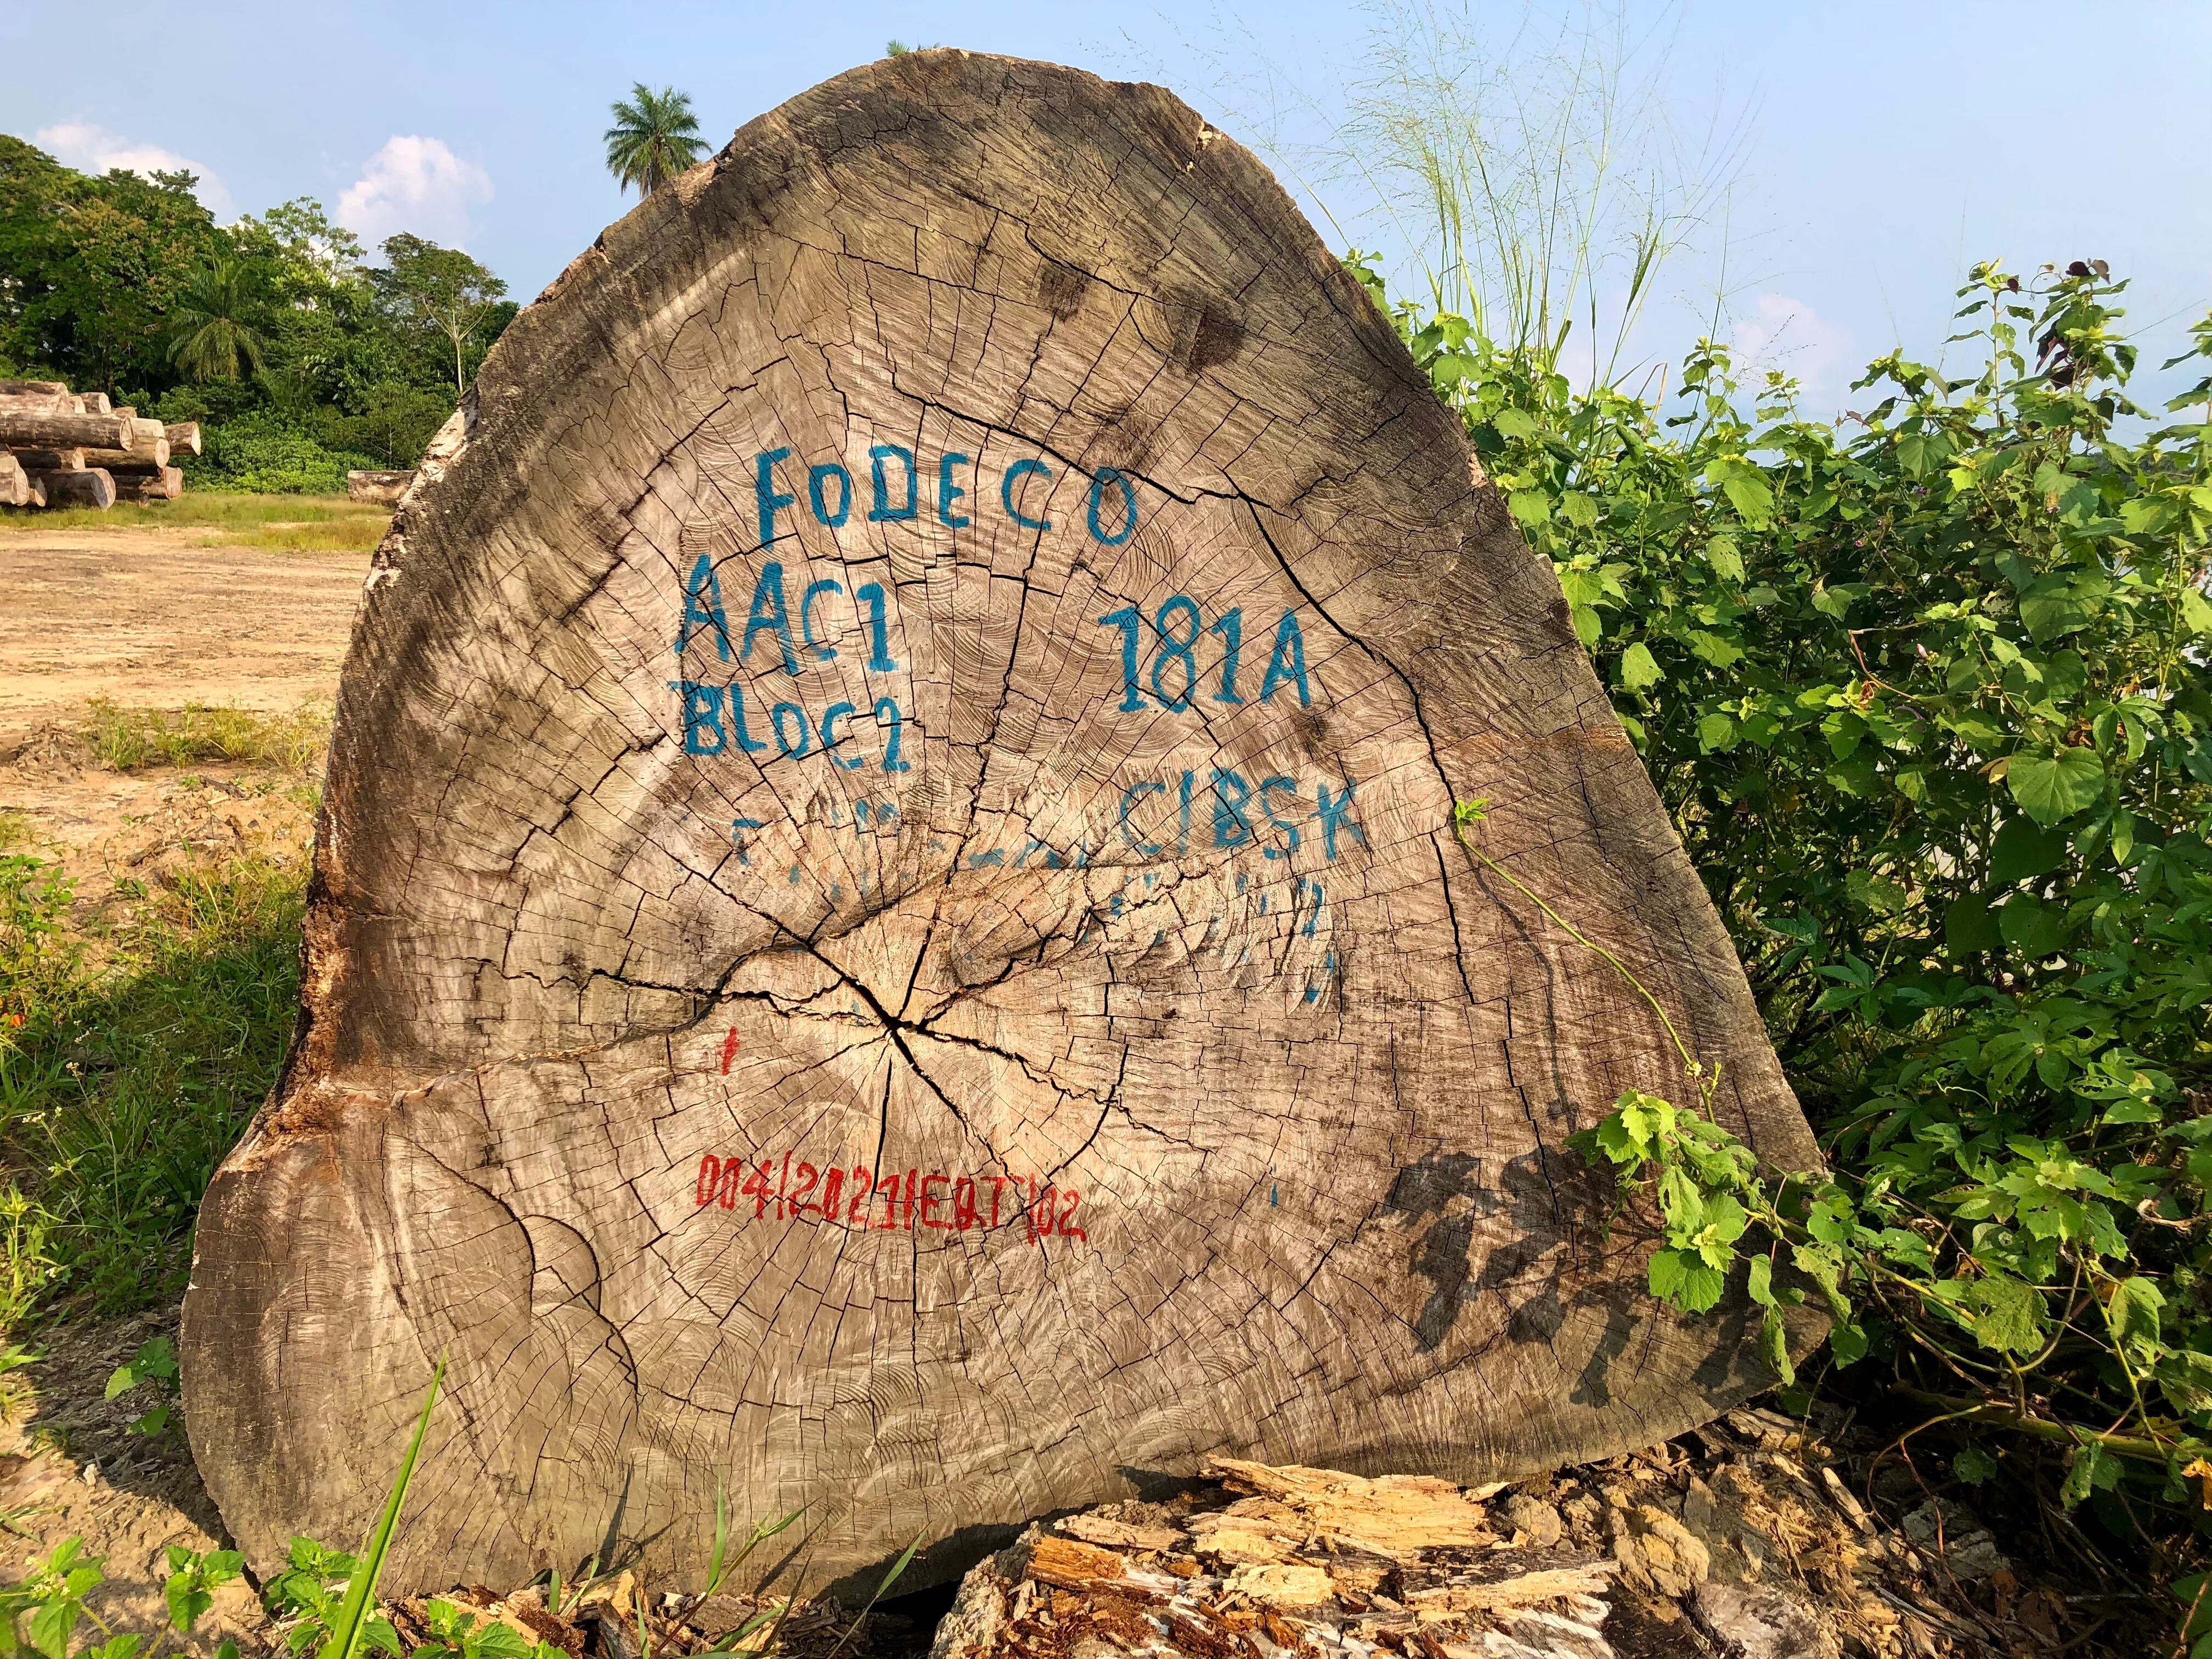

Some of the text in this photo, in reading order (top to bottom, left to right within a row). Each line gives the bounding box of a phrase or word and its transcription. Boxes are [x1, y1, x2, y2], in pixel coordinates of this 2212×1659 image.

[757, 445, 1138, 548] FODECO
[675, 555, 899, 675] AAC1
[1098, 595, 1310, 713] 181A
